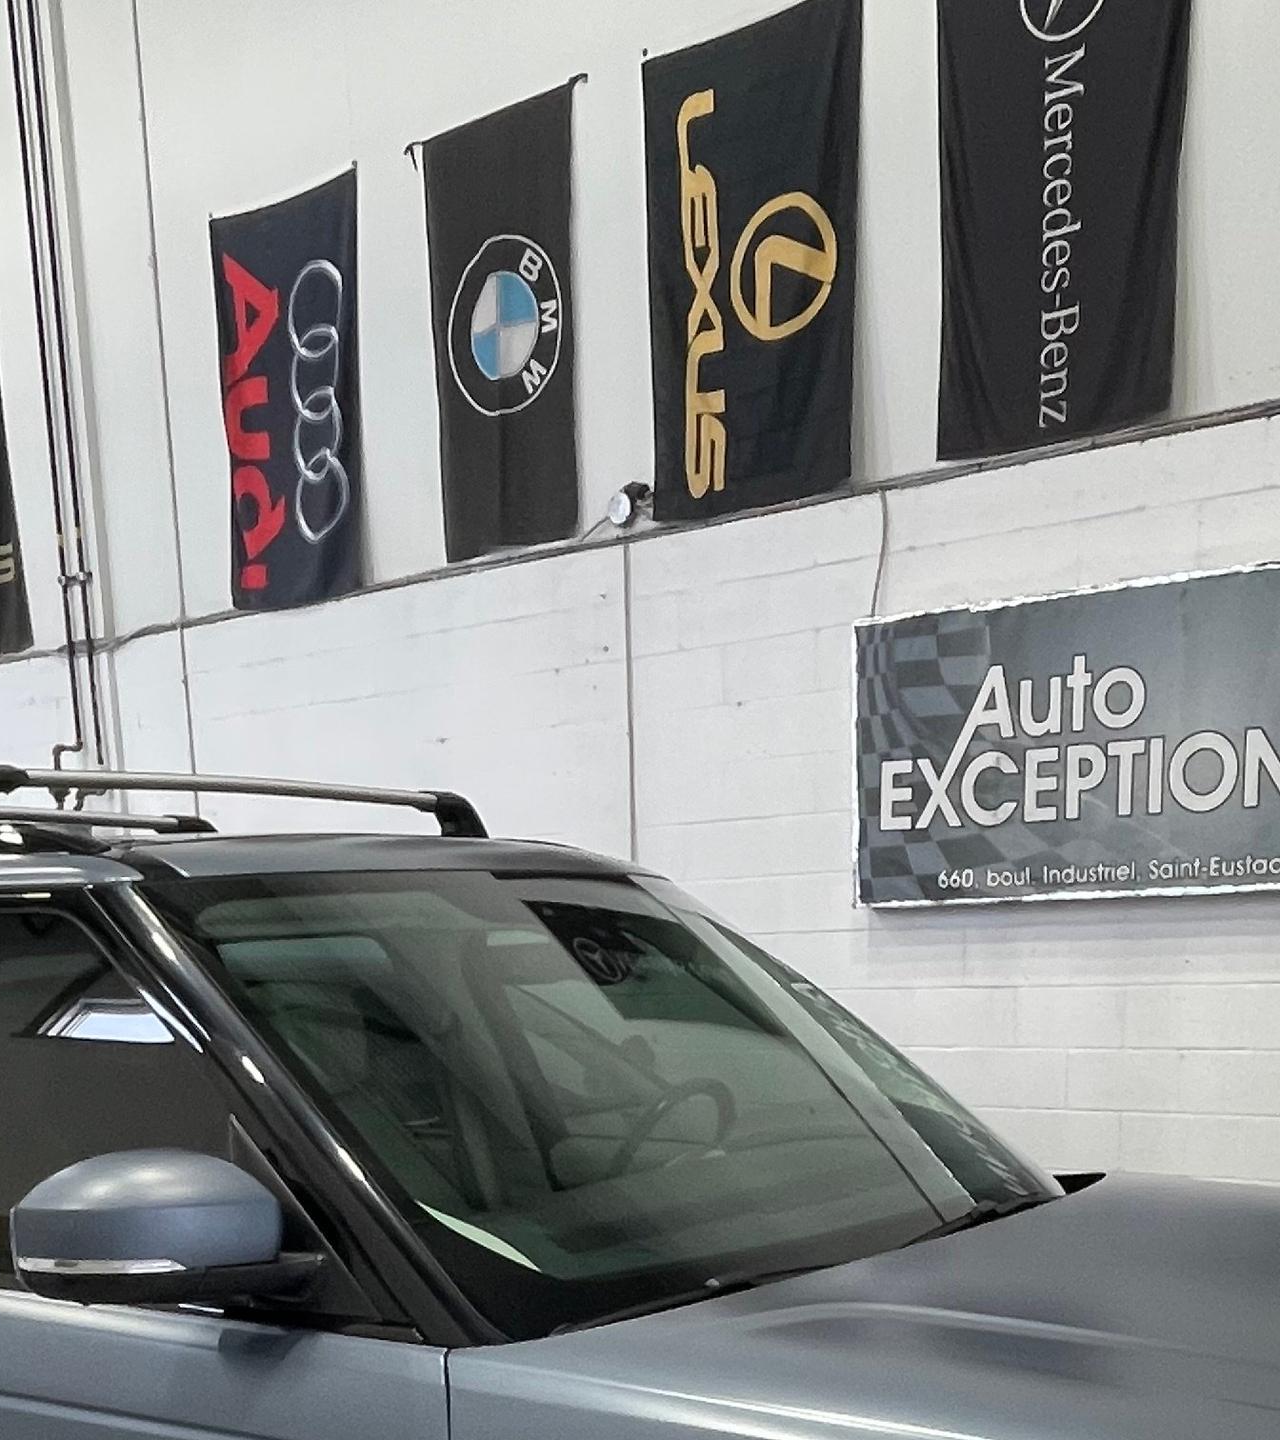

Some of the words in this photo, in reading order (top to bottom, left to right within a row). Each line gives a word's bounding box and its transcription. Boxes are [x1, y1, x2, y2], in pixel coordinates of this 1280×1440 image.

[676, 88, 727, 499] LEXUS
[1038, 42, 1087, 429] Mercedes-Benz
[518, 248, 558, 395] BMW
[965, 654, 1147, 739] Auto
[937, 868, 980, 890] 660,
